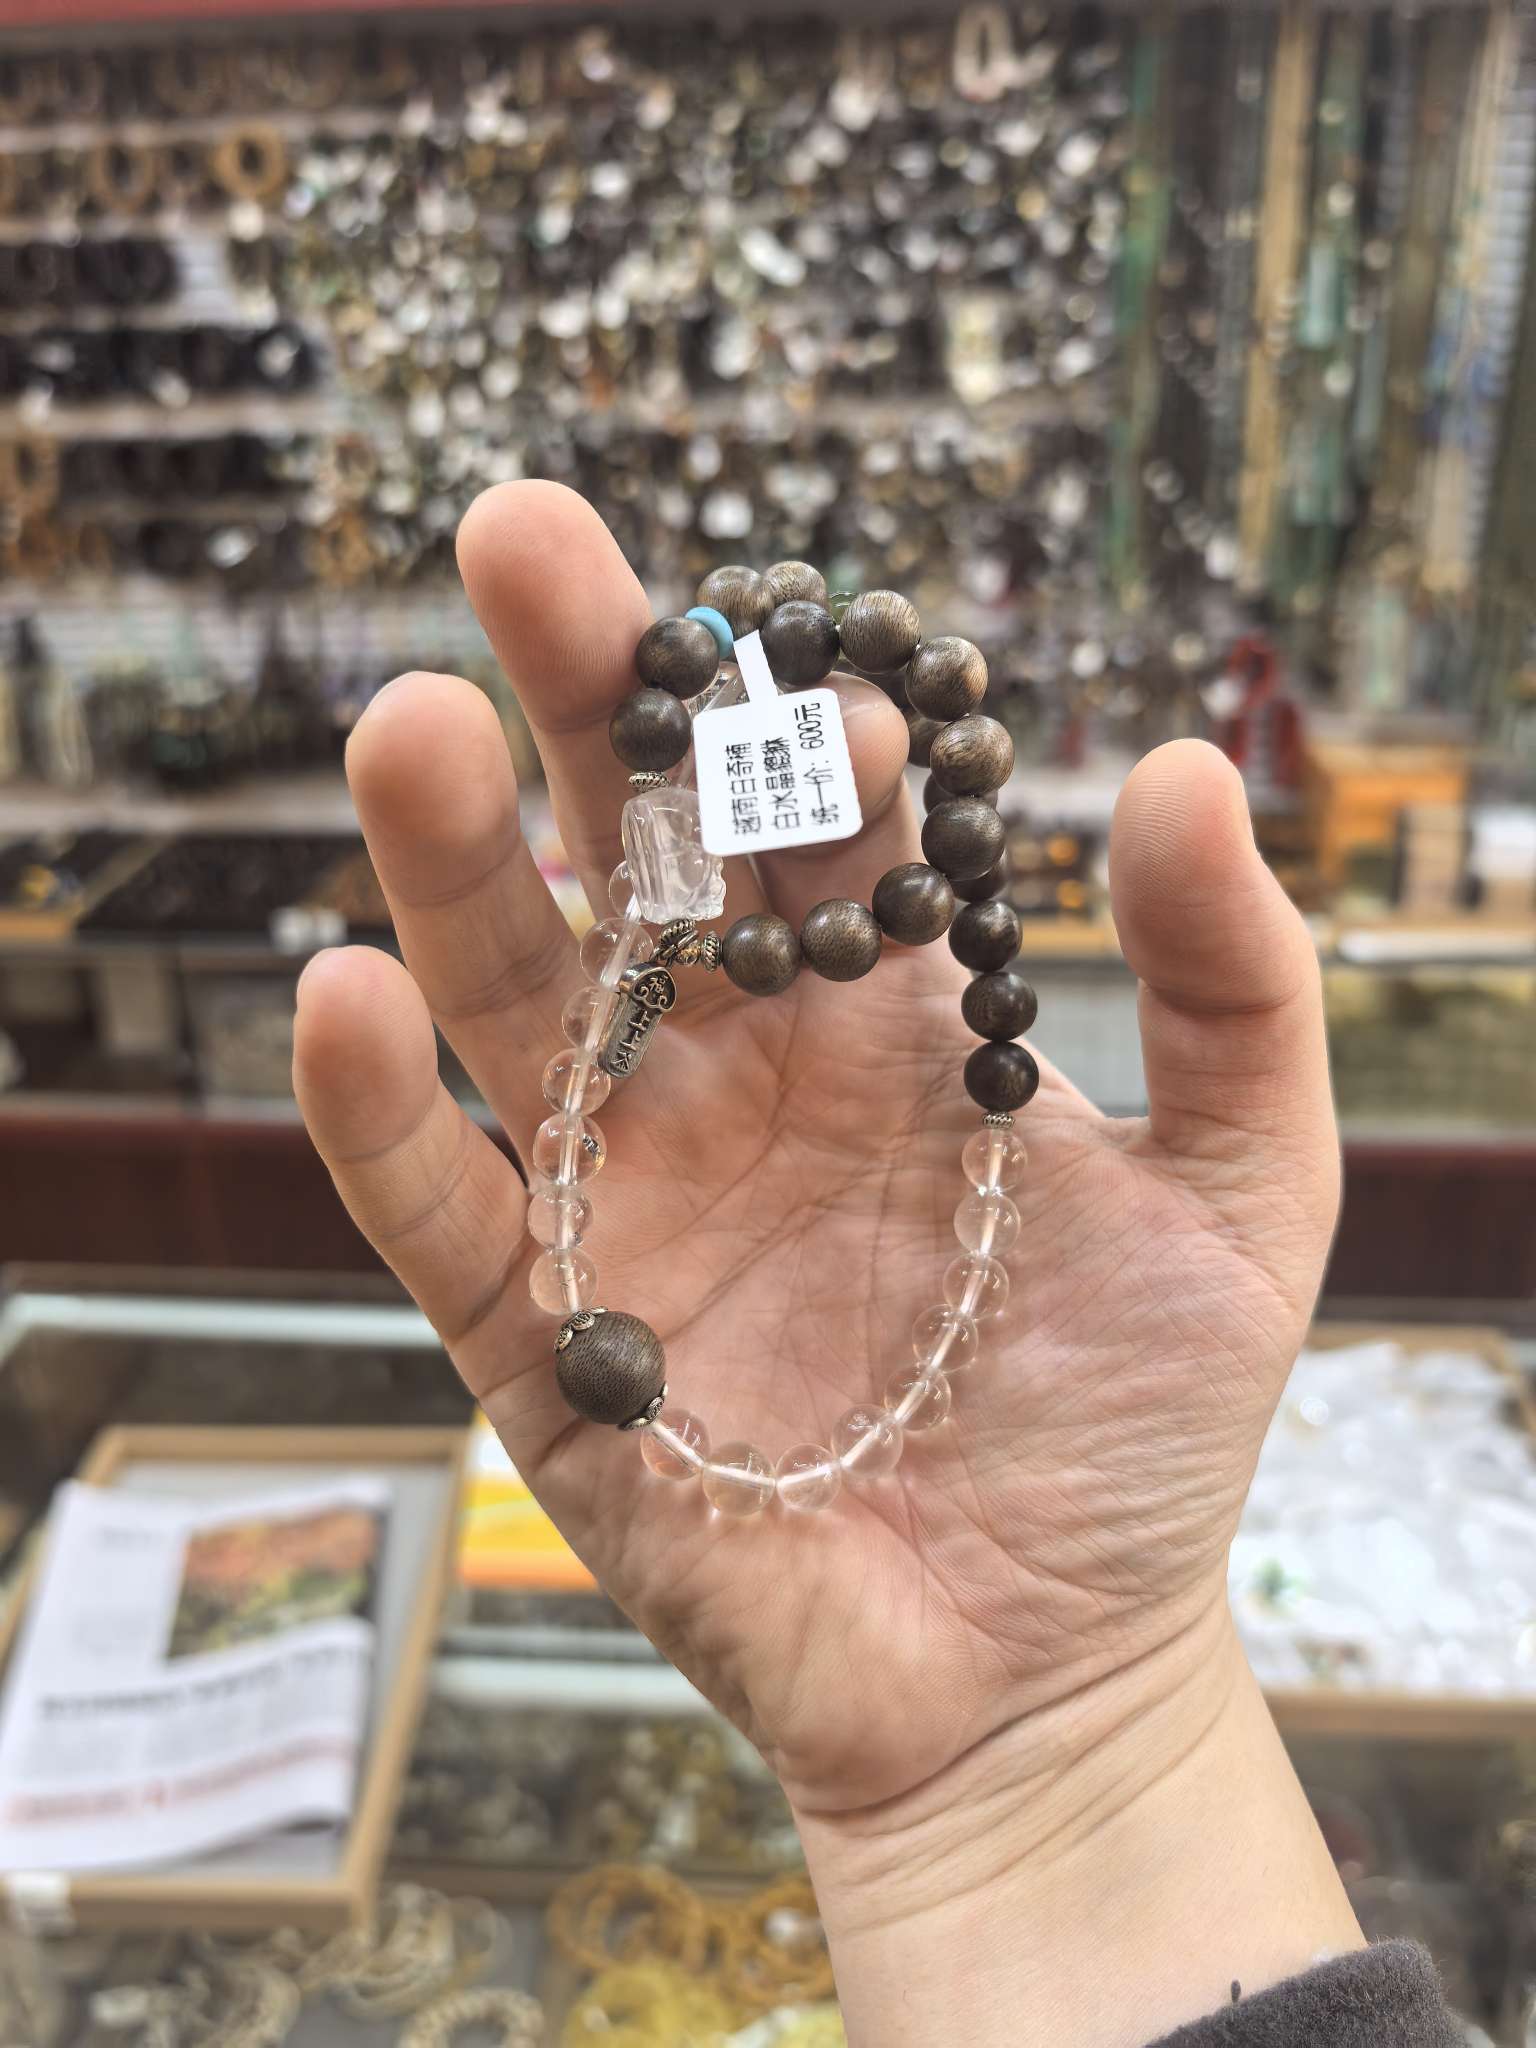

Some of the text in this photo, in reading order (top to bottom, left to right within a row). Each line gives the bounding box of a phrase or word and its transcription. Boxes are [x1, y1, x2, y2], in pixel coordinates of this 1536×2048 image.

[725, 742, 762, 835] 越南白奇楠
[760, 737, 801, 830] 白水晶貔貅
